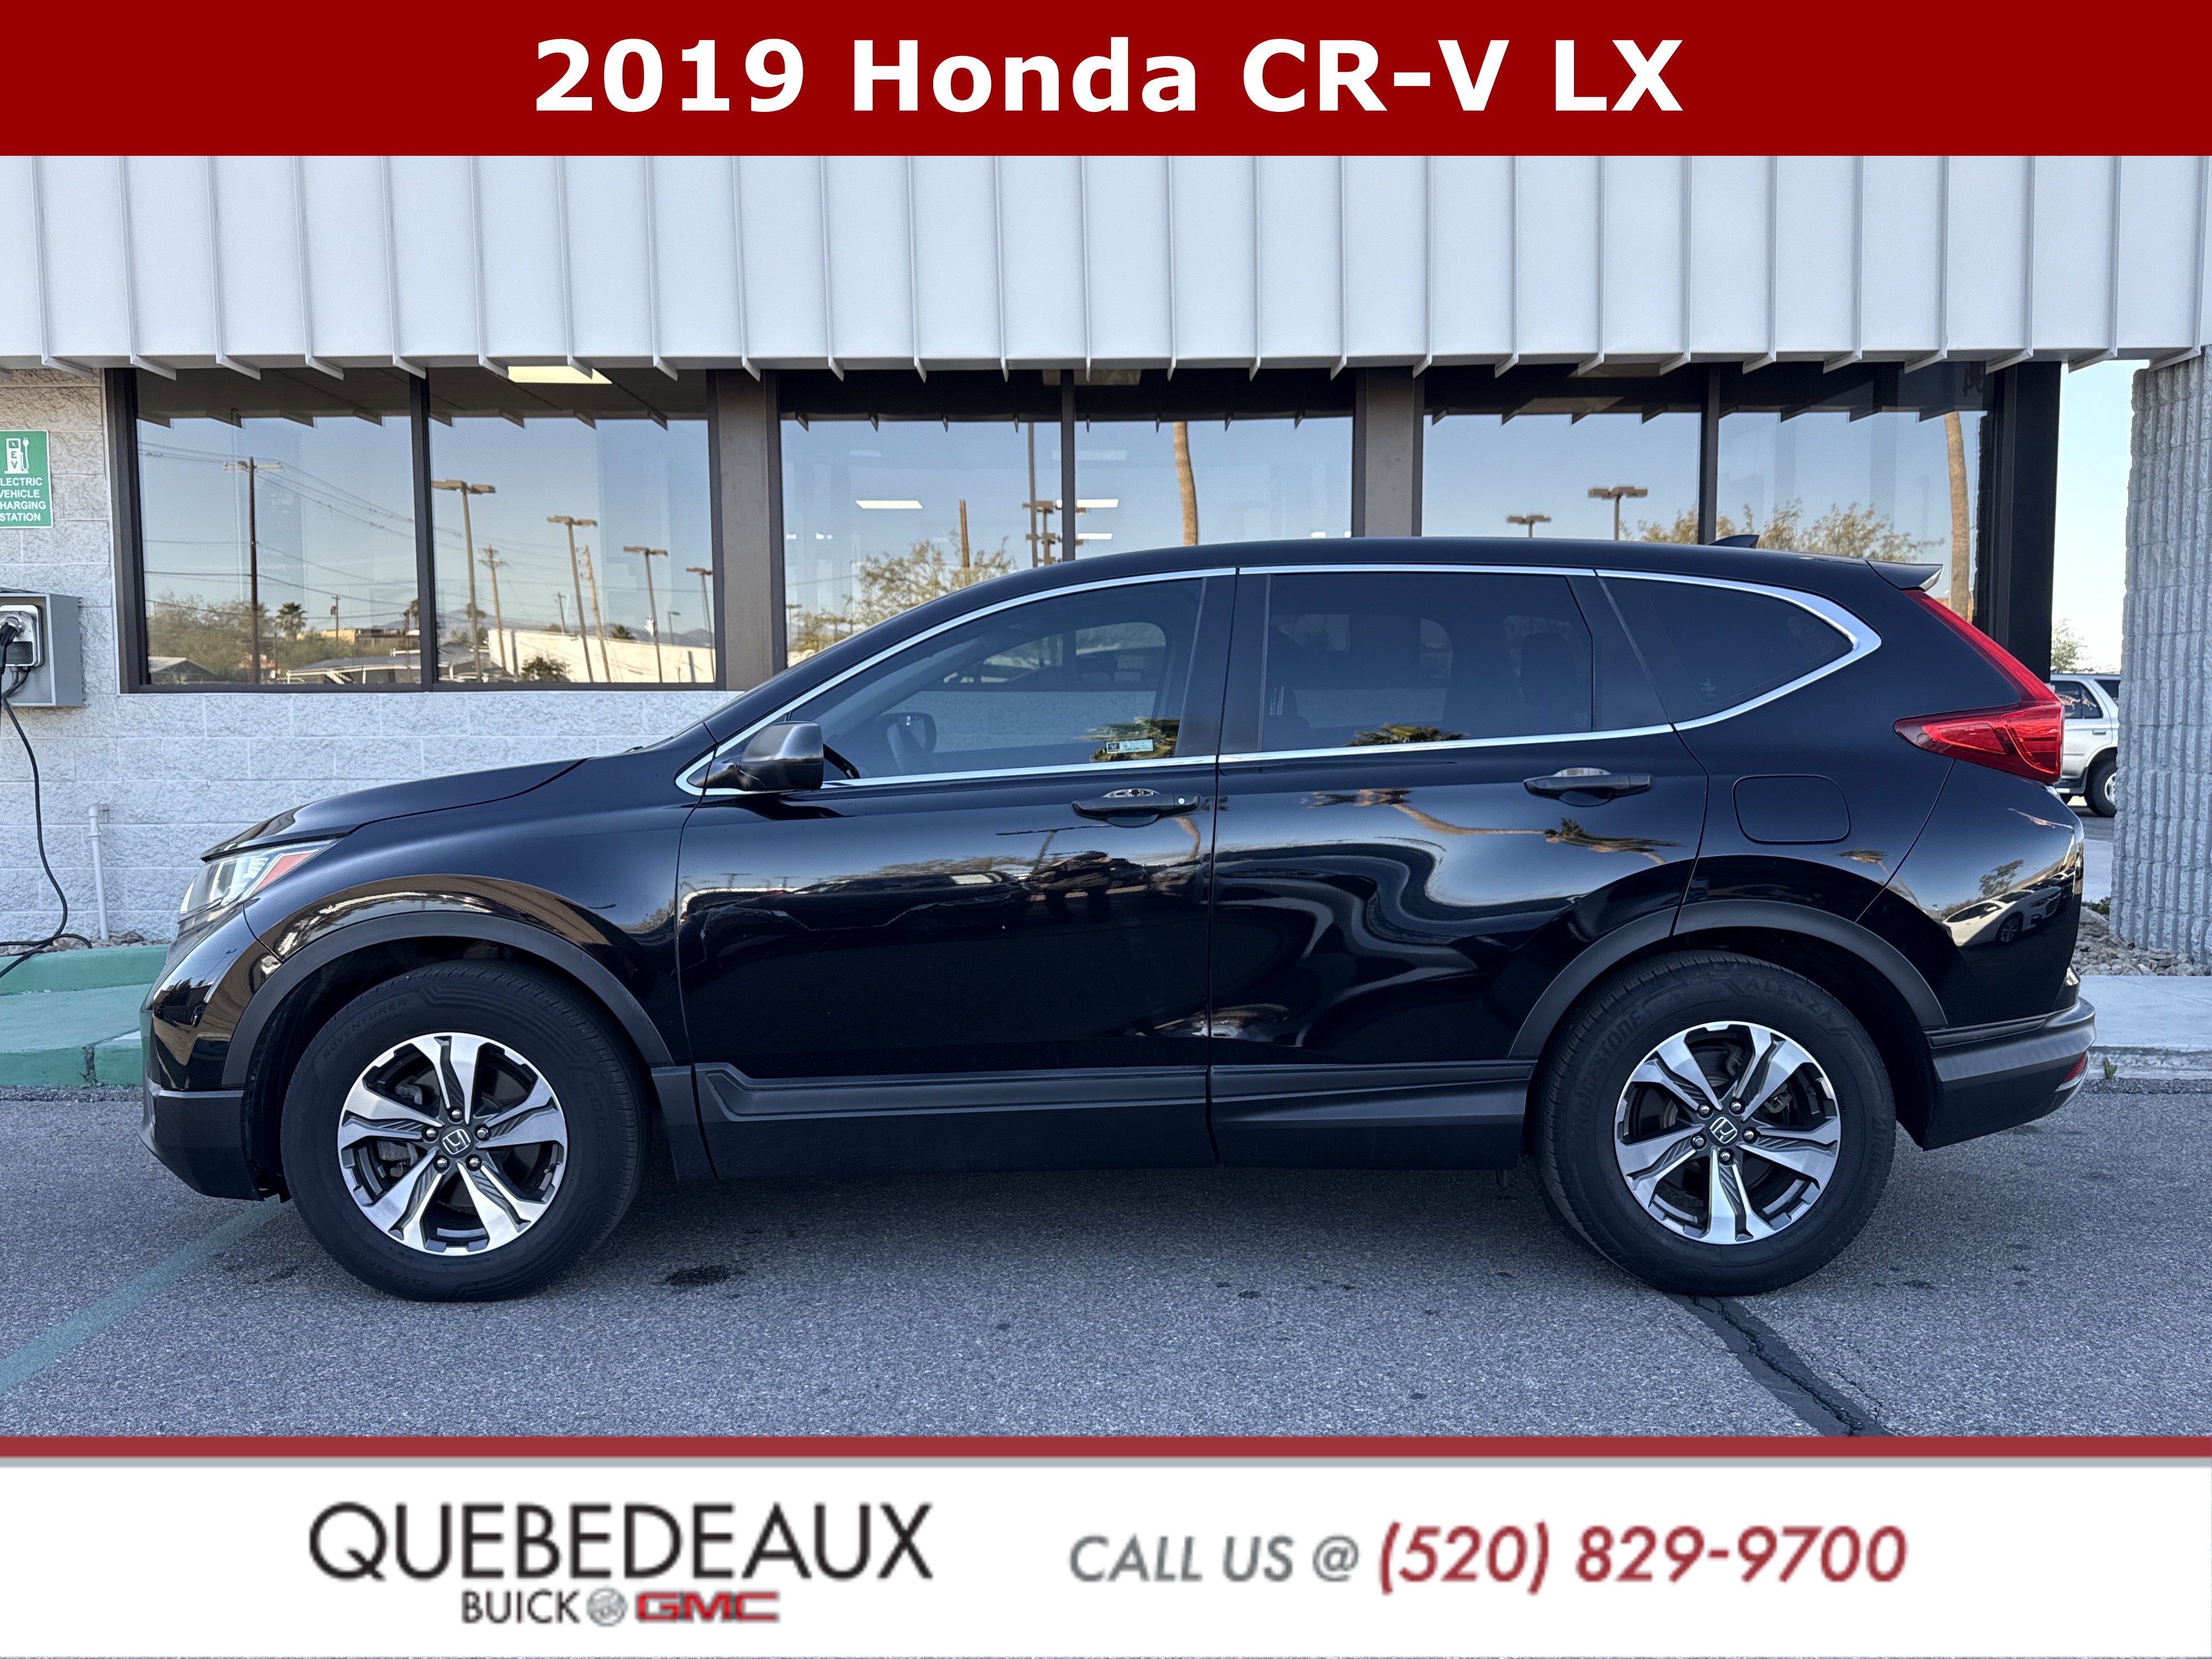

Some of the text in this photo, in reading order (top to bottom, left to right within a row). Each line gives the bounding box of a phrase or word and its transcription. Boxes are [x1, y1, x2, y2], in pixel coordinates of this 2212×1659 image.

[0, 477, 43, 486] LECTRIC
[0, 501, 47, 510] HARGING
[0, 512, 41, 522] STATION
[1746, 977, 1833, 1023] ALENZA
[321, 998, 407, 1060] ADVENTURER
